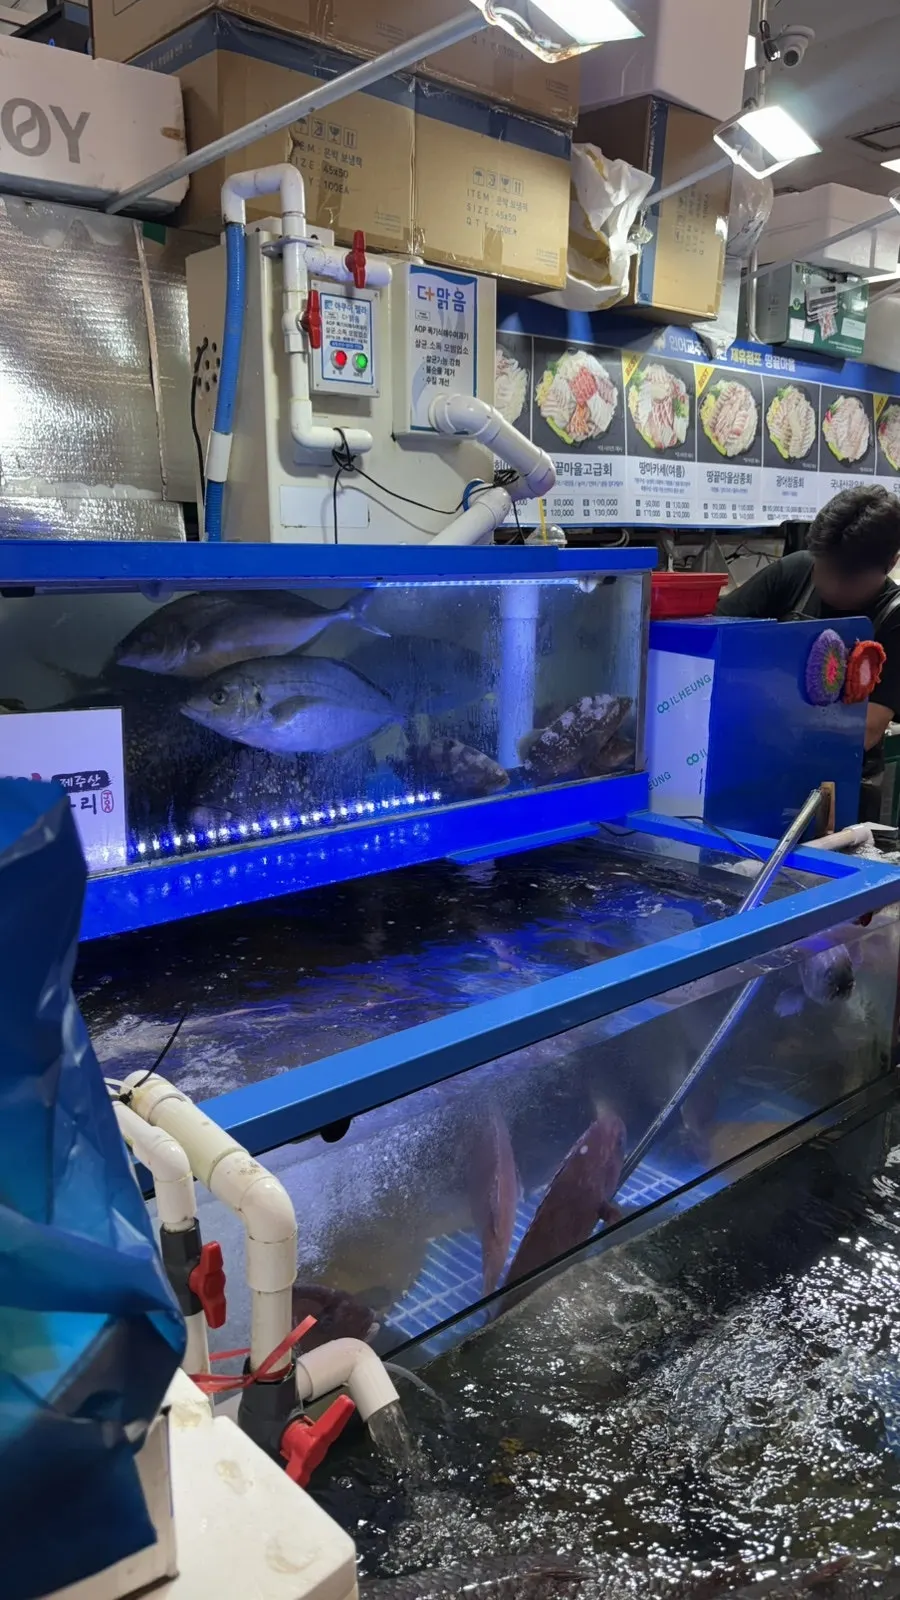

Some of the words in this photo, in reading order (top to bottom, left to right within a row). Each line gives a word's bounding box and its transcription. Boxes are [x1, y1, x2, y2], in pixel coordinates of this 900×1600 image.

[323, 180, 350, 195] 100EA
[466, 188, 490, 202] ITEM
[466, 202, 489, 216] SIZE
[414, 324, 427, 334] AOP
[553, 461, 613, 477] 끝마을고급회
[670, 674, 712, 707] ILHEUNG
[59, 776, 101, 788] 제주산
